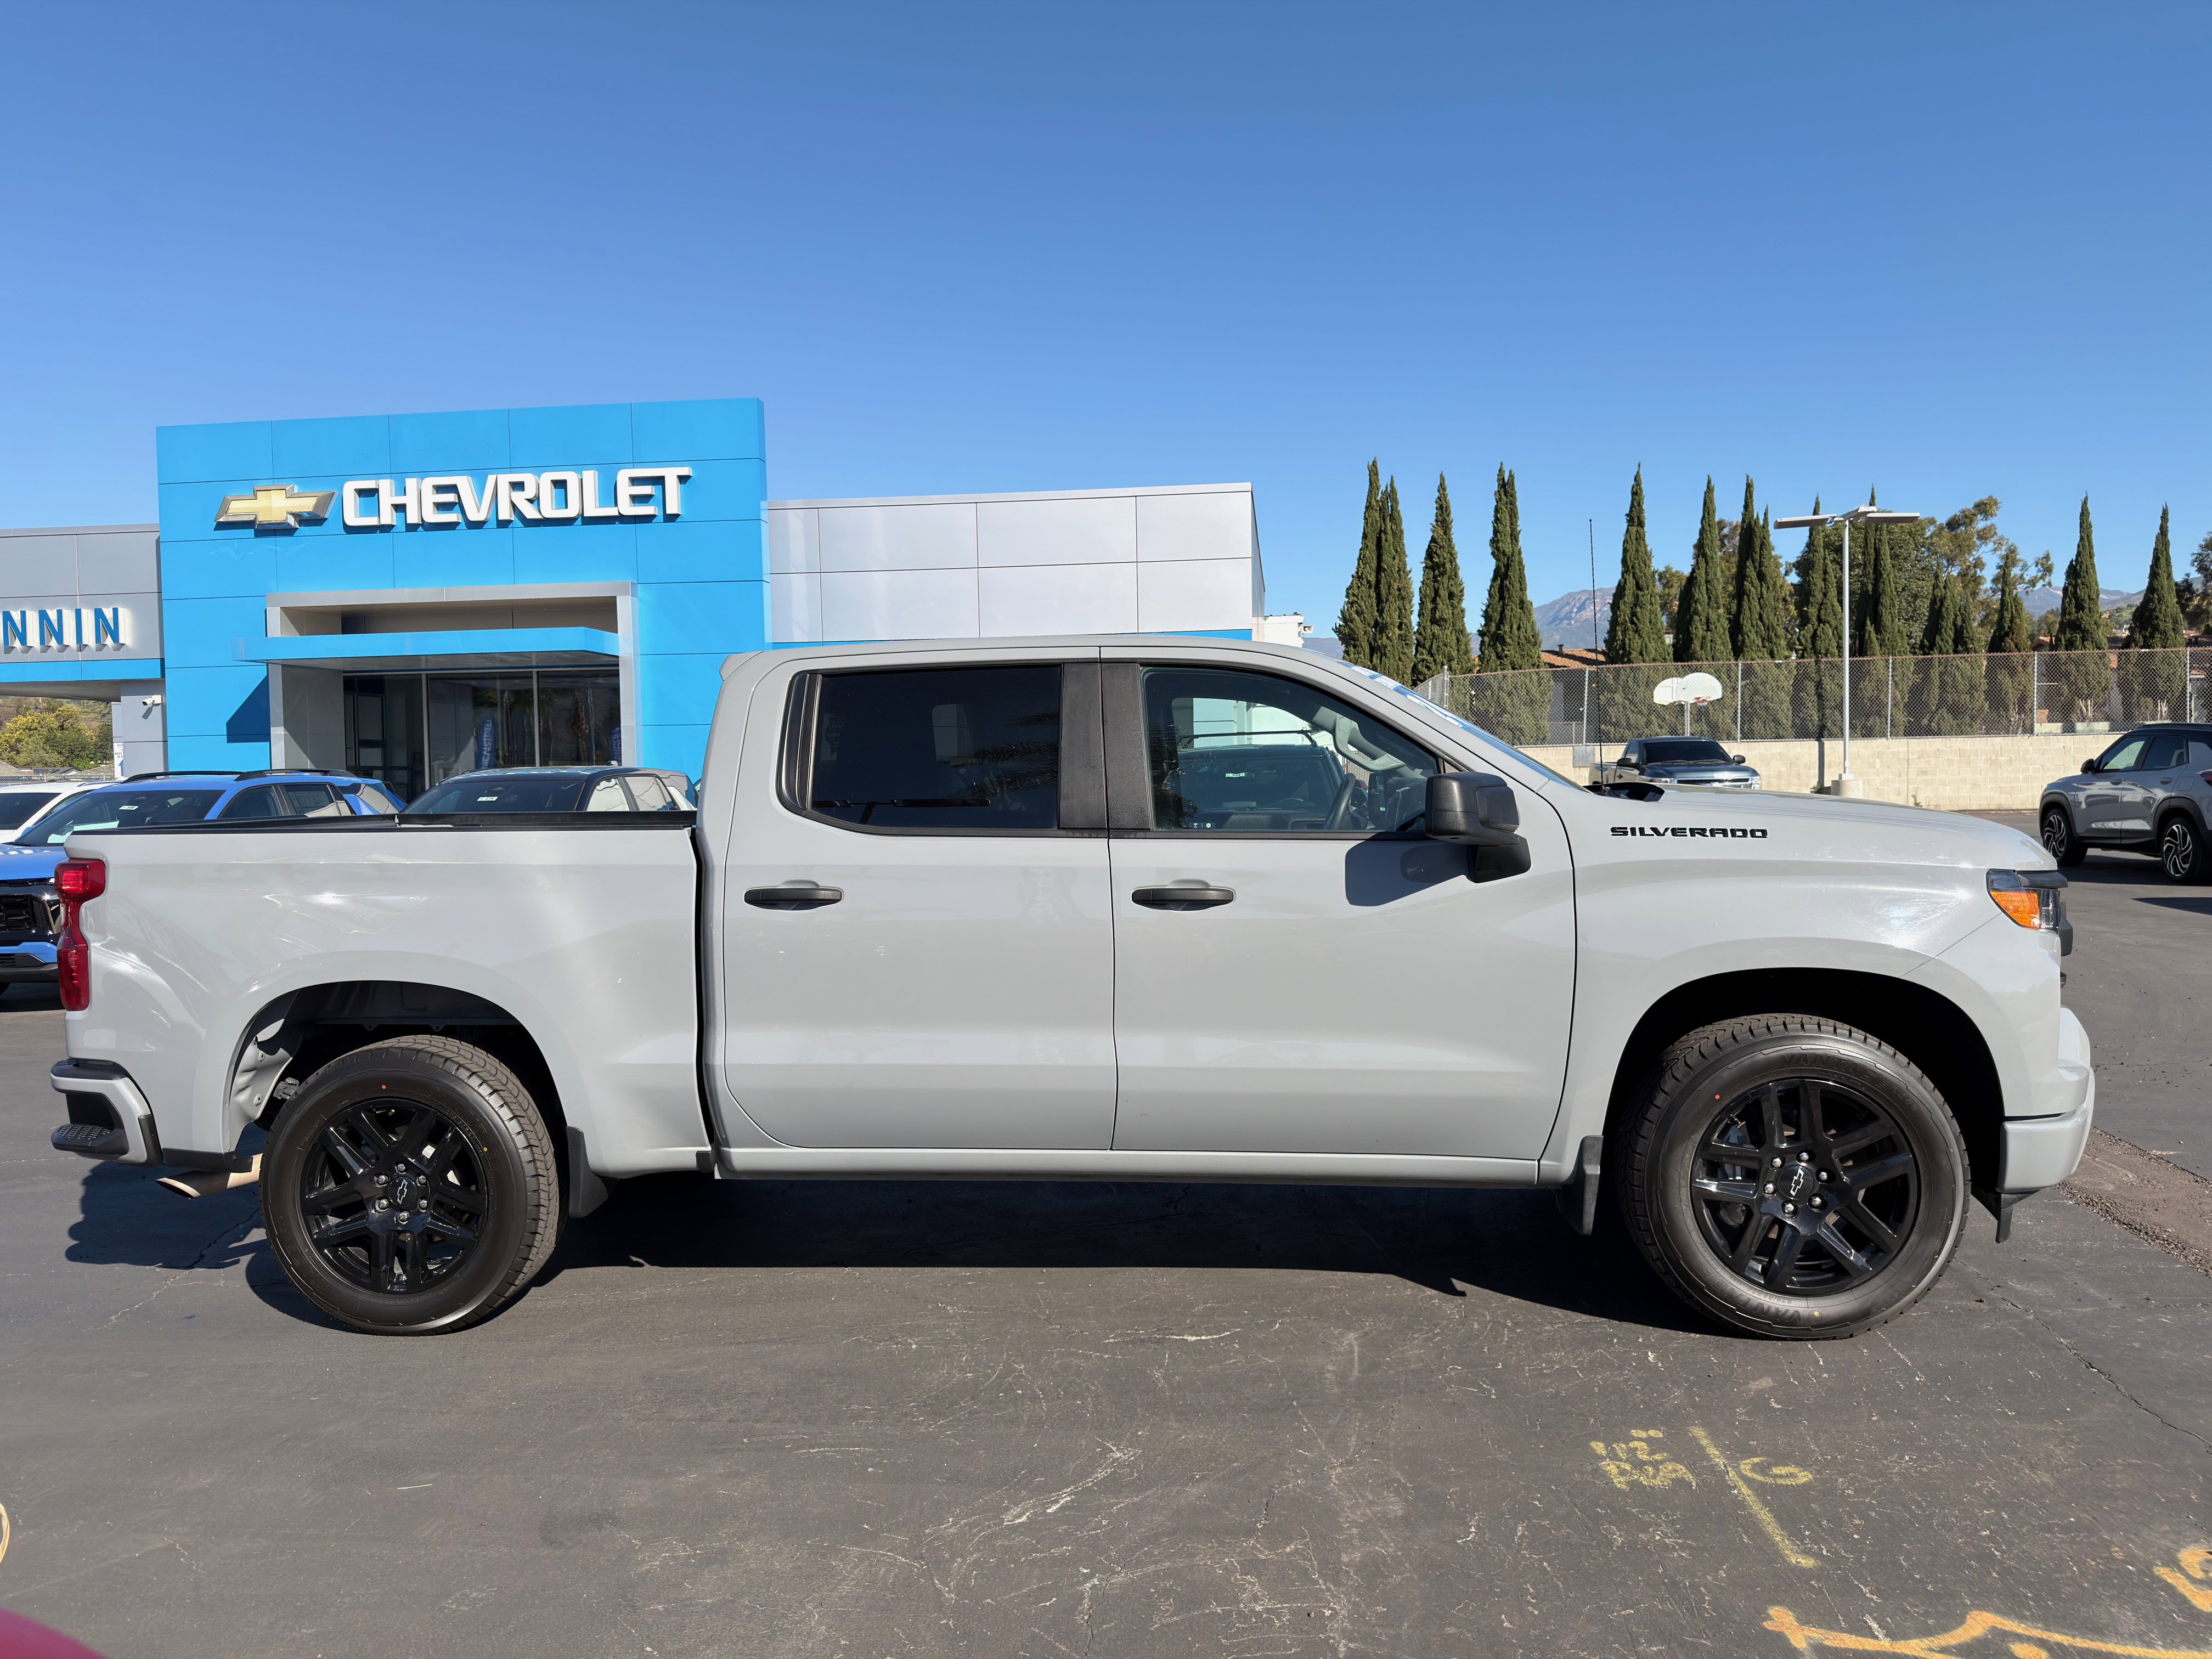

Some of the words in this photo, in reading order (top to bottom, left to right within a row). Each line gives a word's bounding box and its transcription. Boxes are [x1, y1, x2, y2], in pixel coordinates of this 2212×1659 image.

[342, 466, 692, 526] CHEVROLET
[2, 607, 123, 647] NNIN
[1610, 826, 1768, 838] SILVERADO
